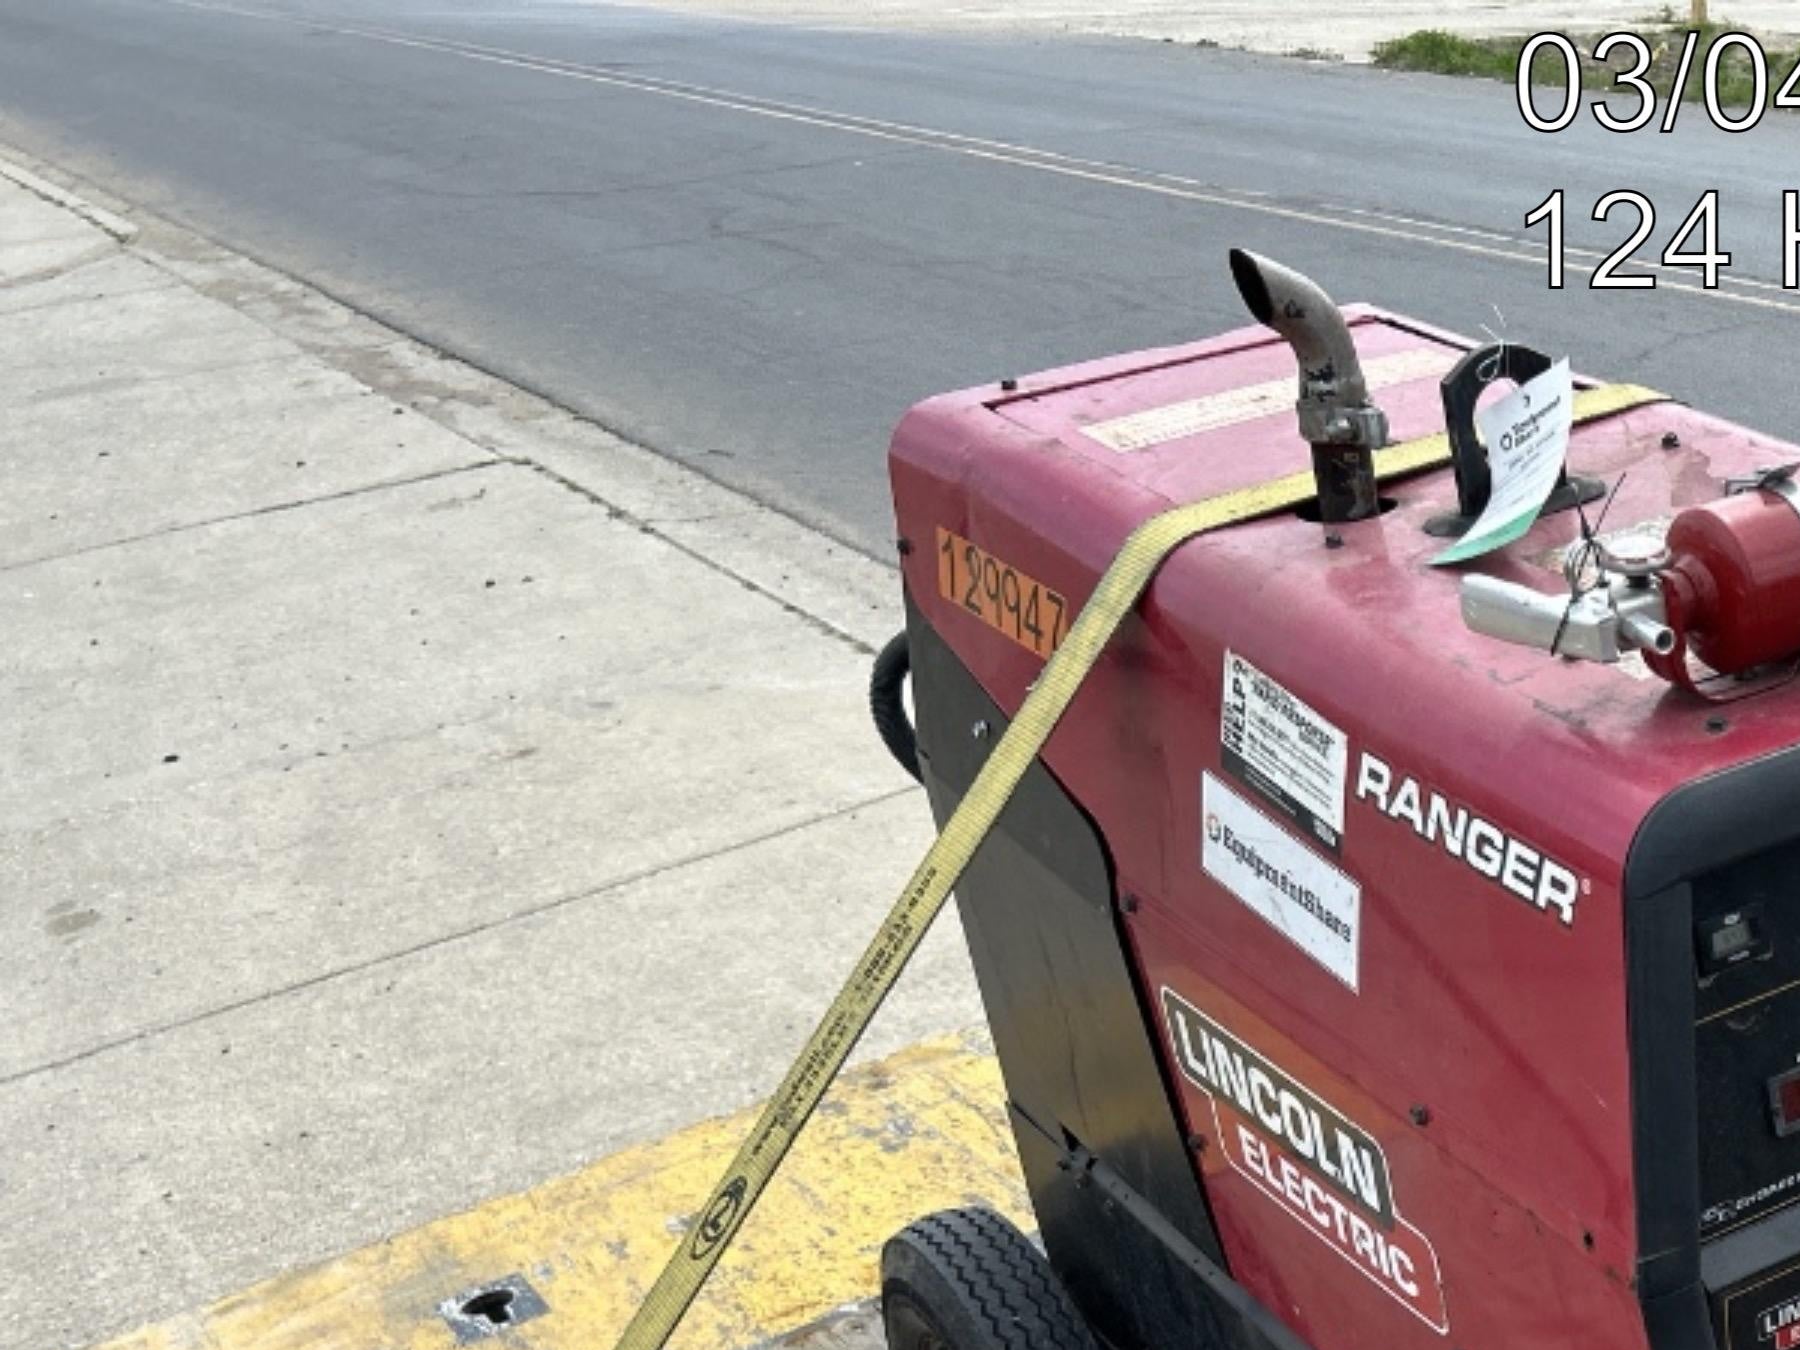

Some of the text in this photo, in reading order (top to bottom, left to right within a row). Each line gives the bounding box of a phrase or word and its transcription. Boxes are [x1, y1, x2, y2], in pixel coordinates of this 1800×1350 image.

[942, 534, 1064, 652] 129947
[1356, 751, 1579, 925] RANGER
[1175, 1009, 1382, 1214] LINCOLN
[1236, 1122, 1421, 1298] ELECTRIC
